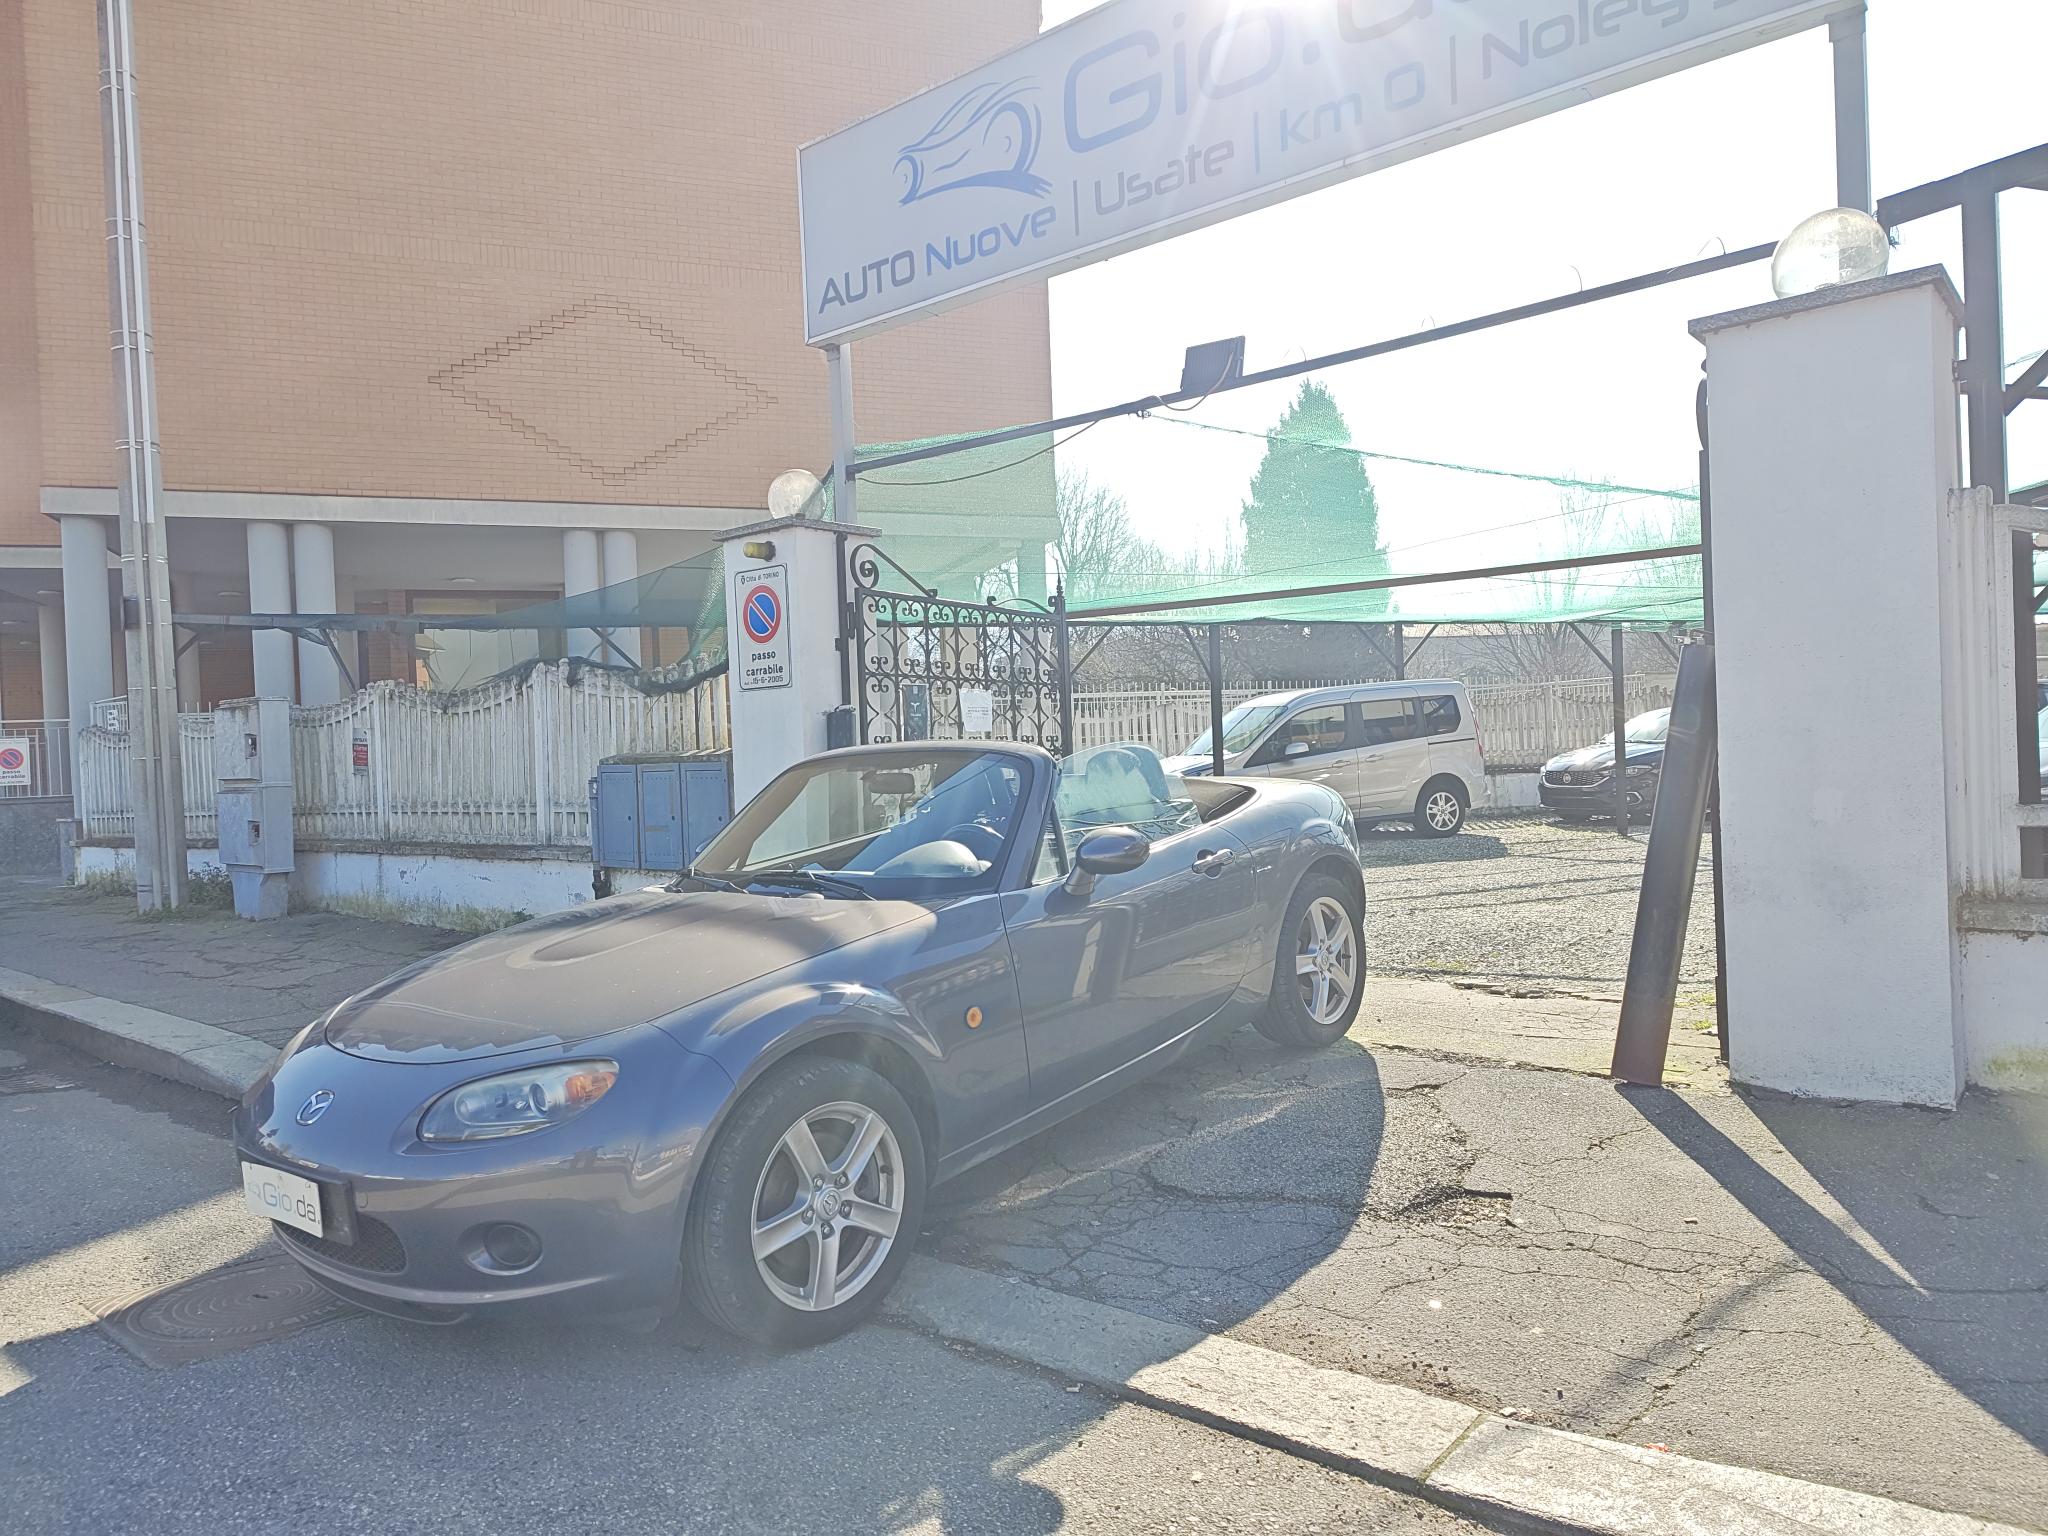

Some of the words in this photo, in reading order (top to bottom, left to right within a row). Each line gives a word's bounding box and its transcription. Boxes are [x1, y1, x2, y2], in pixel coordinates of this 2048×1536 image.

[818, 249, 915, 314] AUTO
[1093, 139, 1235, 215] Usate
[1279, 92, 1362, 151] km
[752, 651, 776, 662] passo
[746, 664, 783, 676] carrabile
